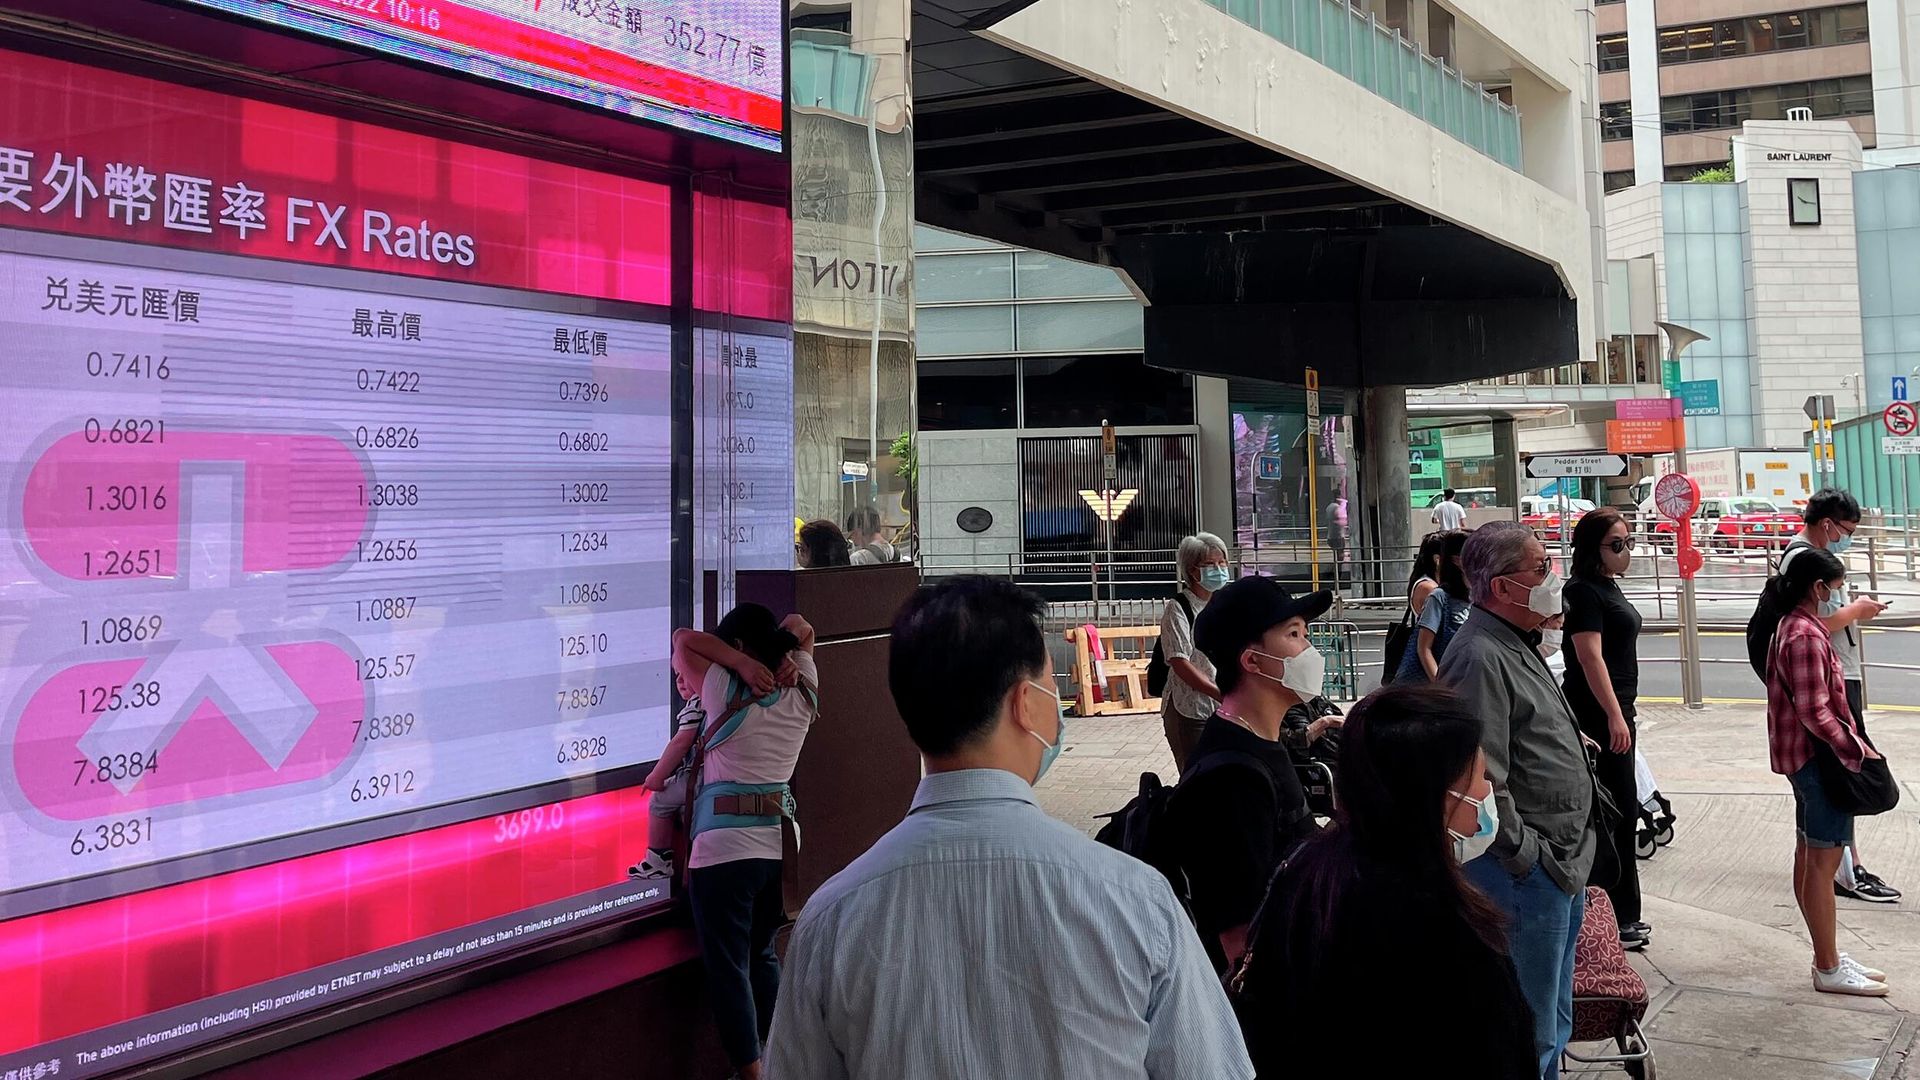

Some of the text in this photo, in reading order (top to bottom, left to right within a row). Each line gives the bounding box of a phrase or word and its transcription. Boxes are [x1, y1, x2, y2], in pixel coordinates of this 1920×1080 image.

[1767, 153, 1832, 161] SAINT LAURENT
[287, 197, 347, 250] FX
[363, 209, 476, 267] Rates
[352, 308, 421, 341] 最高價
[553, 327, 608, 357] 最低價
[87, 352, 609, 403] 0.7416 0.7422 0.7396
[84, 418, 608, 452] 0.6821 0.6826 0.6802
[85, 483, 608, 511] 1.3016 1.3038 1.3002
[84, 532, 608, 576] 1.2651 1.2656 1.2634
[81, 583, 608, 645] 1.0869 1.0887 1.0865
[79, 633, 608, 714] 125.38 125.57 125.10
[73, 686, 607, 786] 7.8384 7.8389 7.8367
[70, 736, 607, 856] 6.3831 6.3912 6.3828
[493, 804, 565, 843] 3699.0
[76, 1051, 97, 1065] The
[100, 1040, 134, 1058] above
[136, 1022, 198, 1048] information
[201, 1007, 249, 1030] (including
[252, 998, 273, 1014] HSI)
[275, 985, 315, 1008] provided
[317, 983, 329, 995] by
[331, 971, 362, 991] ETNET
[363, 968, 382, 981] may
[383, 957, 414, 974] subject
[416, 955, 425, 966] to
[433, 946, 454, 961] delay
[456, 942, 465, 954] of
[466, 939, 479, 951] not
[480, 934, 495, 947] less
[496, 930, 514, 943] than
[515, 925, 523, 936] 15
[524, 918, 552, 934] minutes
[553, 912, 566, 925] and
[567, 912, 573, 922] is
[574, 902, 604, 921] provided
[604, 899, 614, 910] for
[614, 892, 644, 908] reference
[0, 1058, 61, 1080] 僅供參考
